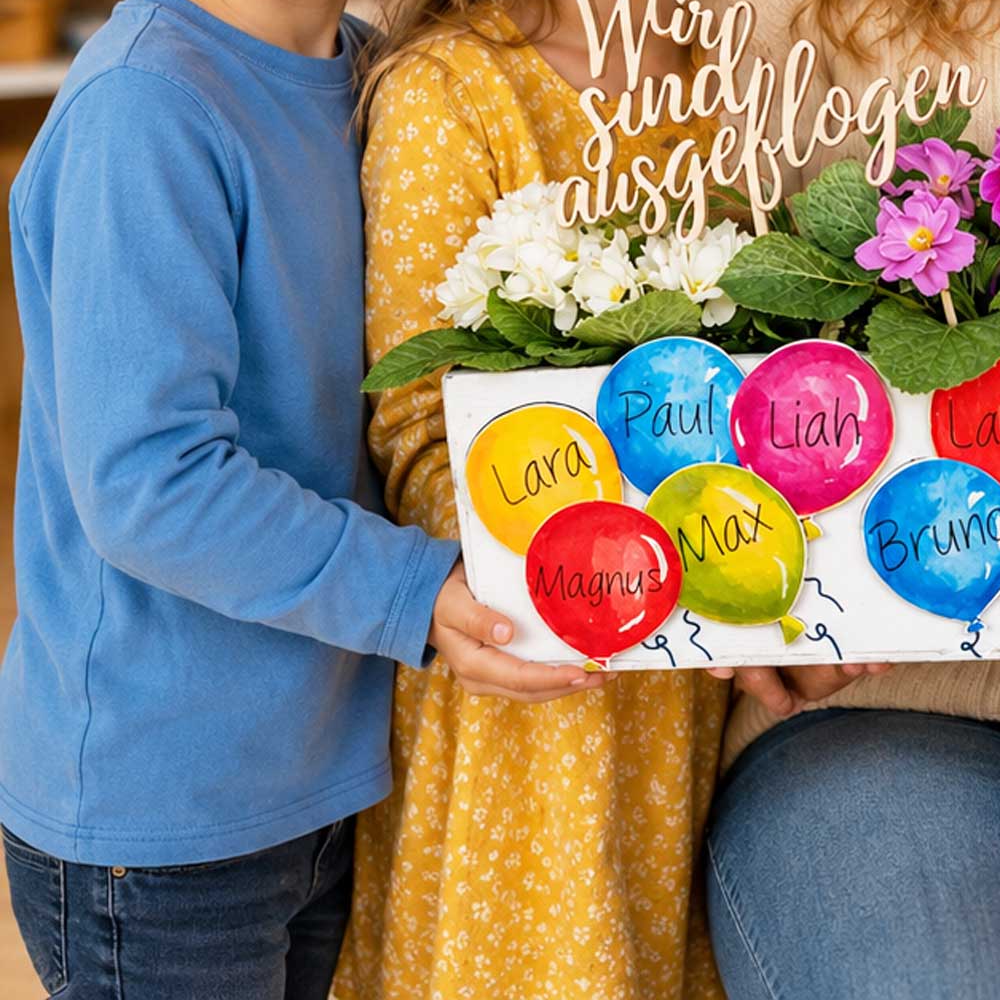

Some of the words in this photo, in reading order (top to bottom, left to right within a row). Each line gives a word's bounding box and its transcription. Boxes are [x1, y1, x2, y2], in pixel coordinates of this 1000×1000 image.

[576, 0, 754, 172] sind
[556, 39, 987, 244] ausgeflogen
[619, 385, 715, 438] Paul
[770, 397, 861, 449] Liah
[491, 440, 592, 506] Lara
[678, 503, 773, 573] Max
[534, 565, 663, 607] Magnus
